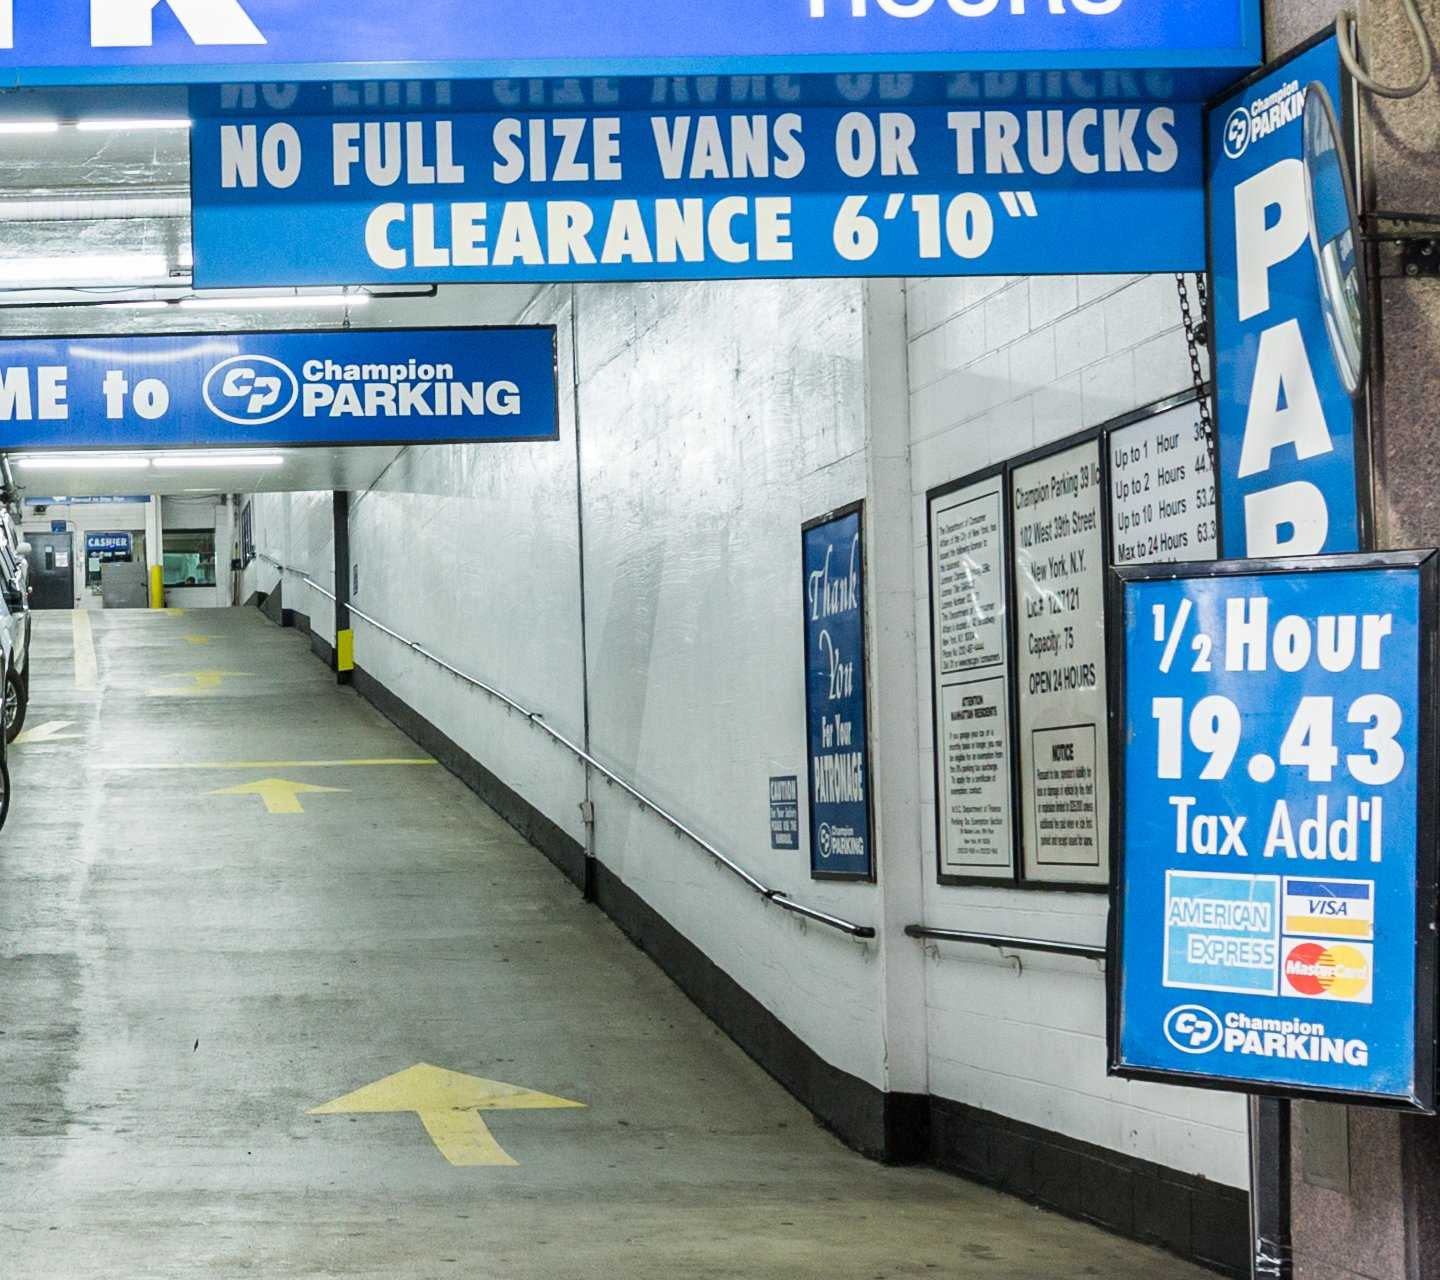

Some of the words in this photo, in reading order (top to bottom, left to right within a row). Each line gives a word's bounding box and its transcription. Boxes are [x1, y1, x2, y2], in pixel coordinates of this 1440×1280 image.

[1251, 80, 1299, 117] Champion
[1251, 87, 1308, 143] PARKIN
[220, 121, 301, 189] NO
[333, 119, 464, 187] FULL
[493, 116, 623, 183] SIZE
[653, 113, 804, 180] VANS
[836, 111, 918, 177] OR
[947, 106, 1178, 175] TRUCKS
[364, 195, 792, 270] CLEARANCE
[302, 358, 453, 383] Champion
[1234, 158, 1334, 558] PA
[103, 369, 170, 420] to
[302, 380, 520, 417] PARKING
[1115, 448, 1128, 471] Up
[1130, 446, 1140, 462] to
[1143, 440, 1148, 458] 1
[1157, 433, 1179, 454] Hour
[1015, 482, 1050, 510] Champion
[1051, 472, 1078, 498] Parking
[1116, 480, 1129, 502] Up
[1132, 478, 1141, 495] to
[1144, 473, 1150, 491] 2
[1158, 465, 1185, 487] Hours
[1195, 453, 1212, 473] 44.
[1034, 521, 1052, 544] West
[1072, 507, 1097, 534] Street
[1118, 511, 1129, 534] Up
[1132, 510, 1140, 526] to
[1143, 504, 1153, 524] 10
[1159, 499, 1186, 519] Hours
[88, 537, 127, 548] CASHIER
[1118, 543, 1136, 562] Max
[1137, 541, 1146, 558] to
[1148, 535, 1159, 556] 24
[1160, 532, 1188, 552] Hours
[809, 534, 858, 621] Thank
[1031, 560, 1047, 582] New
[1064, 626, 1074, 649] 75
[1225, 596, 1393, 673] Hour
[819, 630, 853, 699] You
[1029, 670, 1051, 695] OPEN
[1053, 668, 1062, 692] 24
[1064, 663, 1096, 689] HOURS
[1152, 694, 1406, 786] 19.43
[815, 752, 863, 803] PATRONAGE
[1169, 795, 1249, 857] Tax
[1263, 795, 1383, 863] Add'l
[1170, 901, 1268, 928] AMERICAN
[1308, 900, 1348, 916] VISA
[1191, 938, 1274, 965] EXPRESS
[1286, 960, 1367, 979] MasterCard
[1224, 1012, 1325, 1036] Champion
[1224, 1027, 1369, 1066] PARKING
